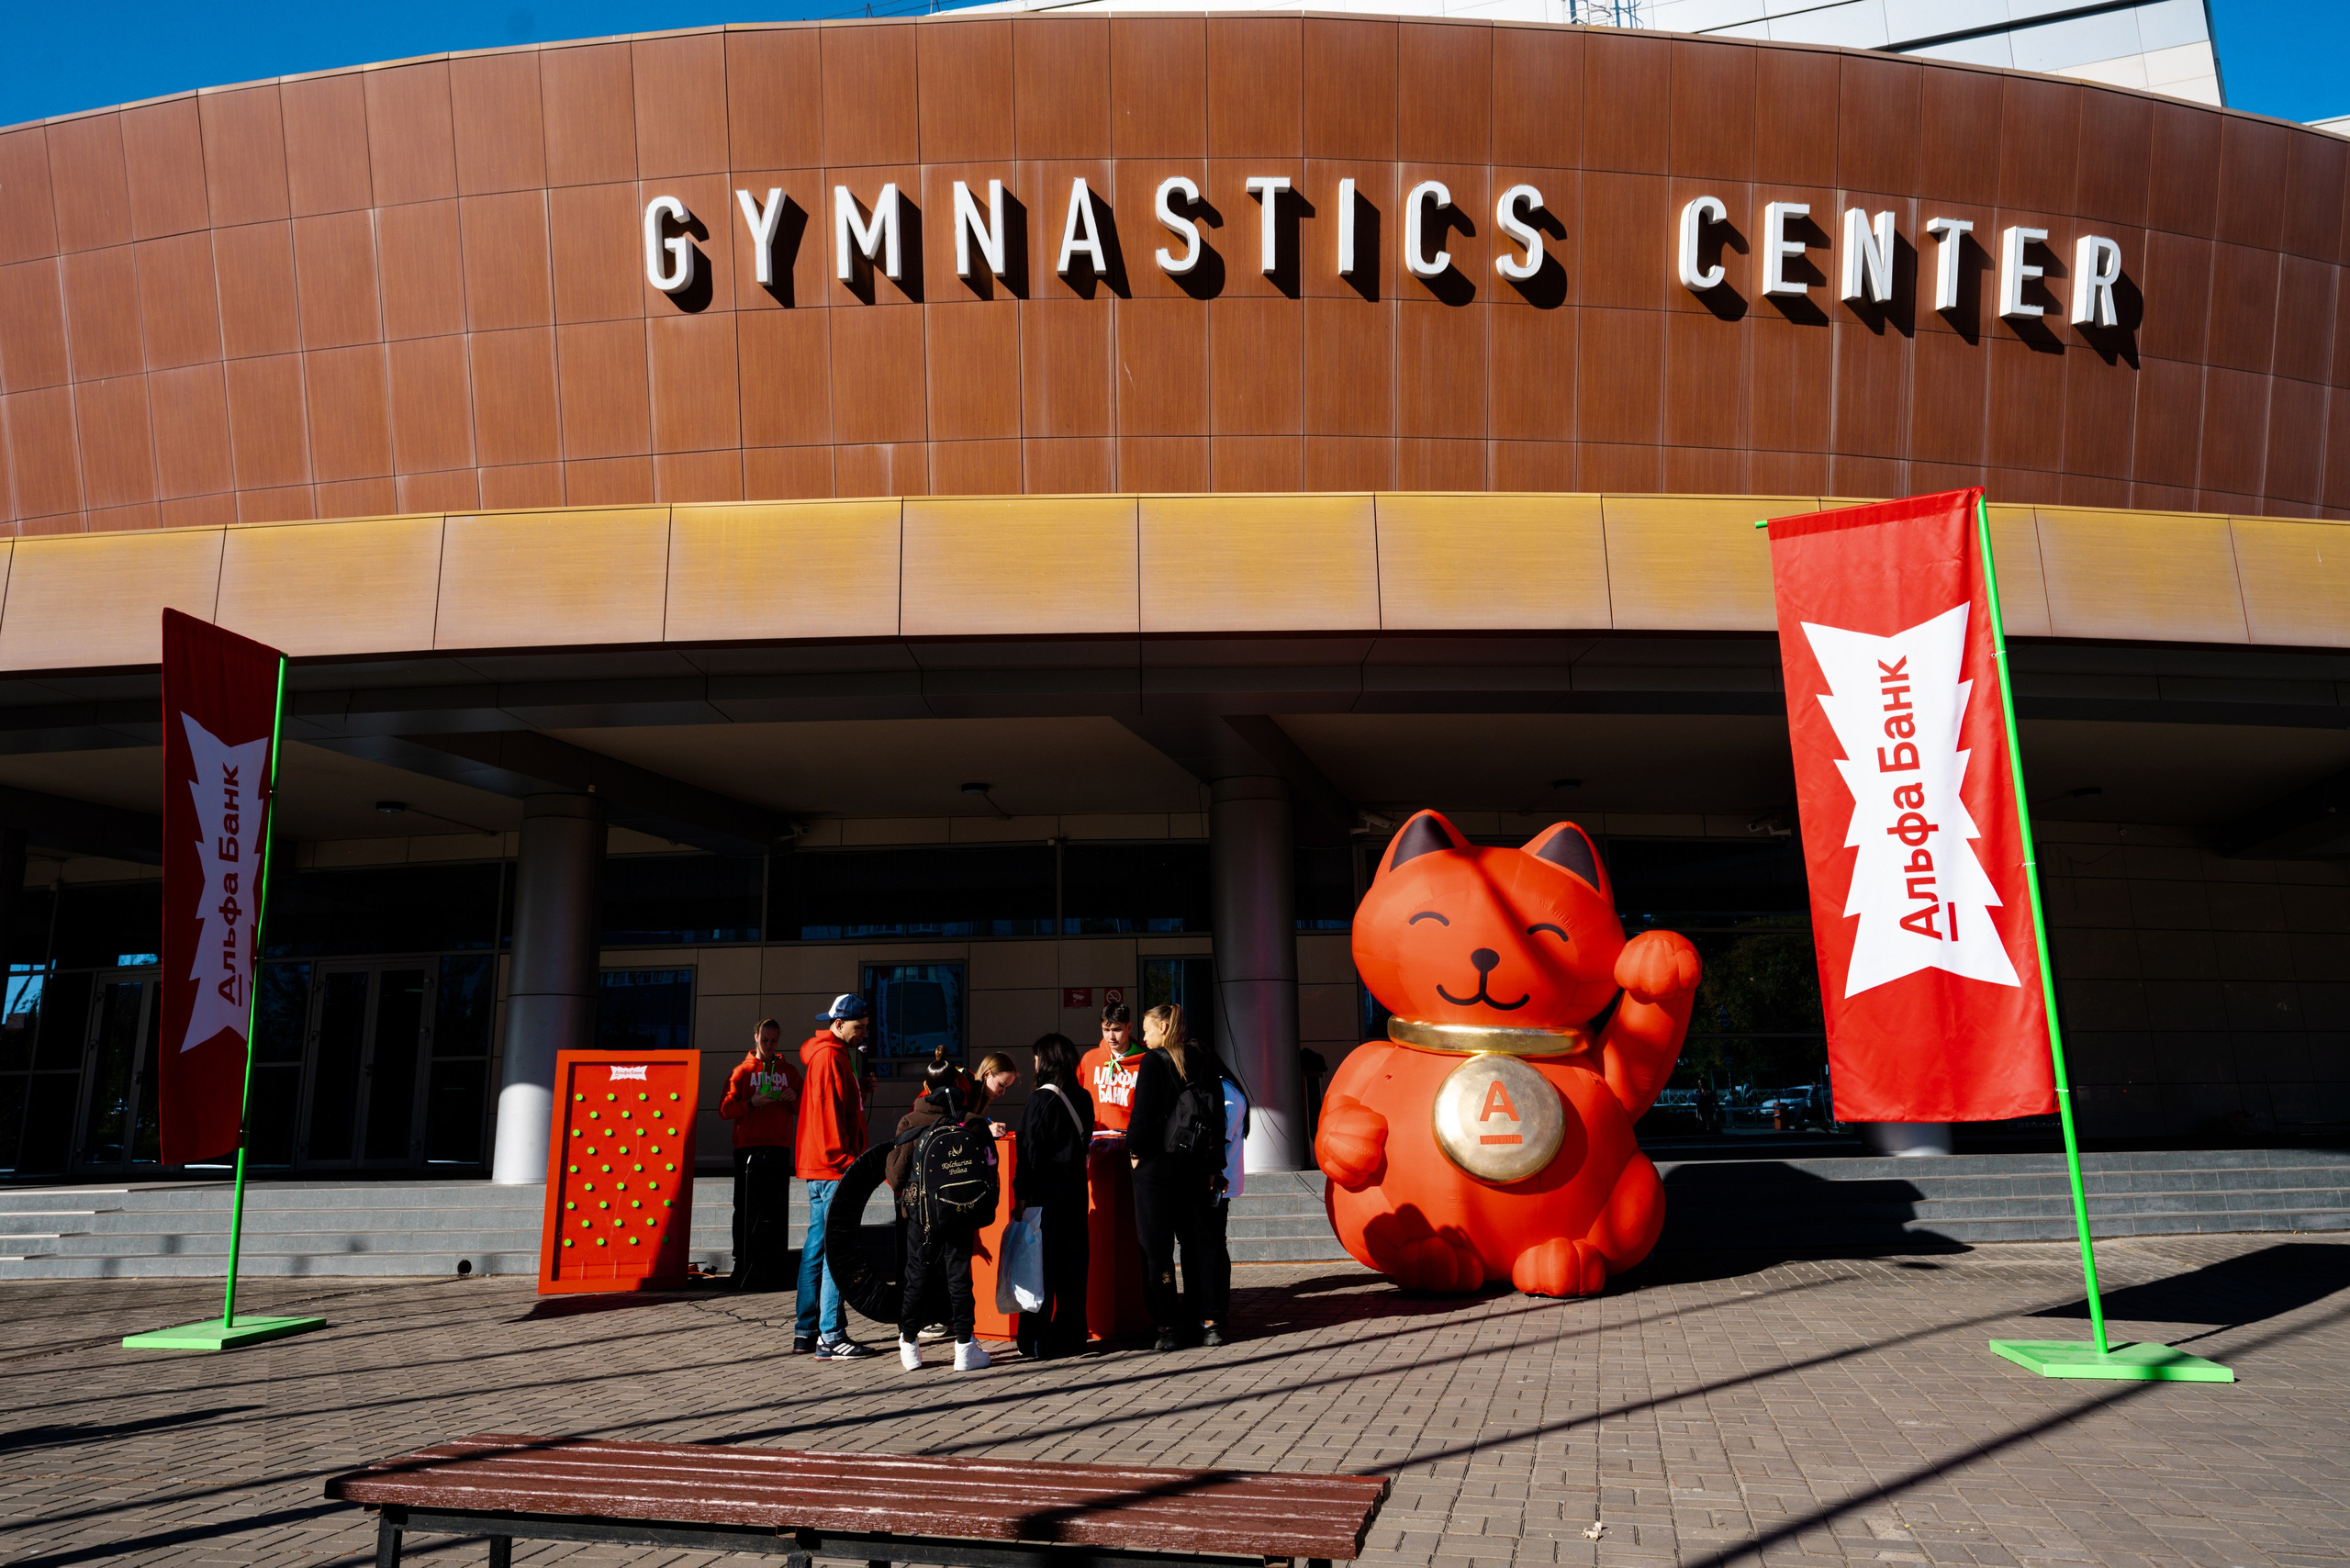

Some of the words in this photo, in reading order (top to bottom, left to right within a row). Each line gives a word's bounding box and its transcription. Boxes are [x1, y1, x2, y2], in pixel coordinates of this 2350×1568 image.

[644, 176, 1544, 294] GYMNASTICS
[1678, 196, 2122, 329] CENTER
[1876, 655, 1920, 774] Банк
[218, 762, 240, 864] Банк
[1886, 781, 1943, 942] Альфа
[218, 871, 242, 1005] Альфа
[1098, 1084, 1130, 1107] БАНК
